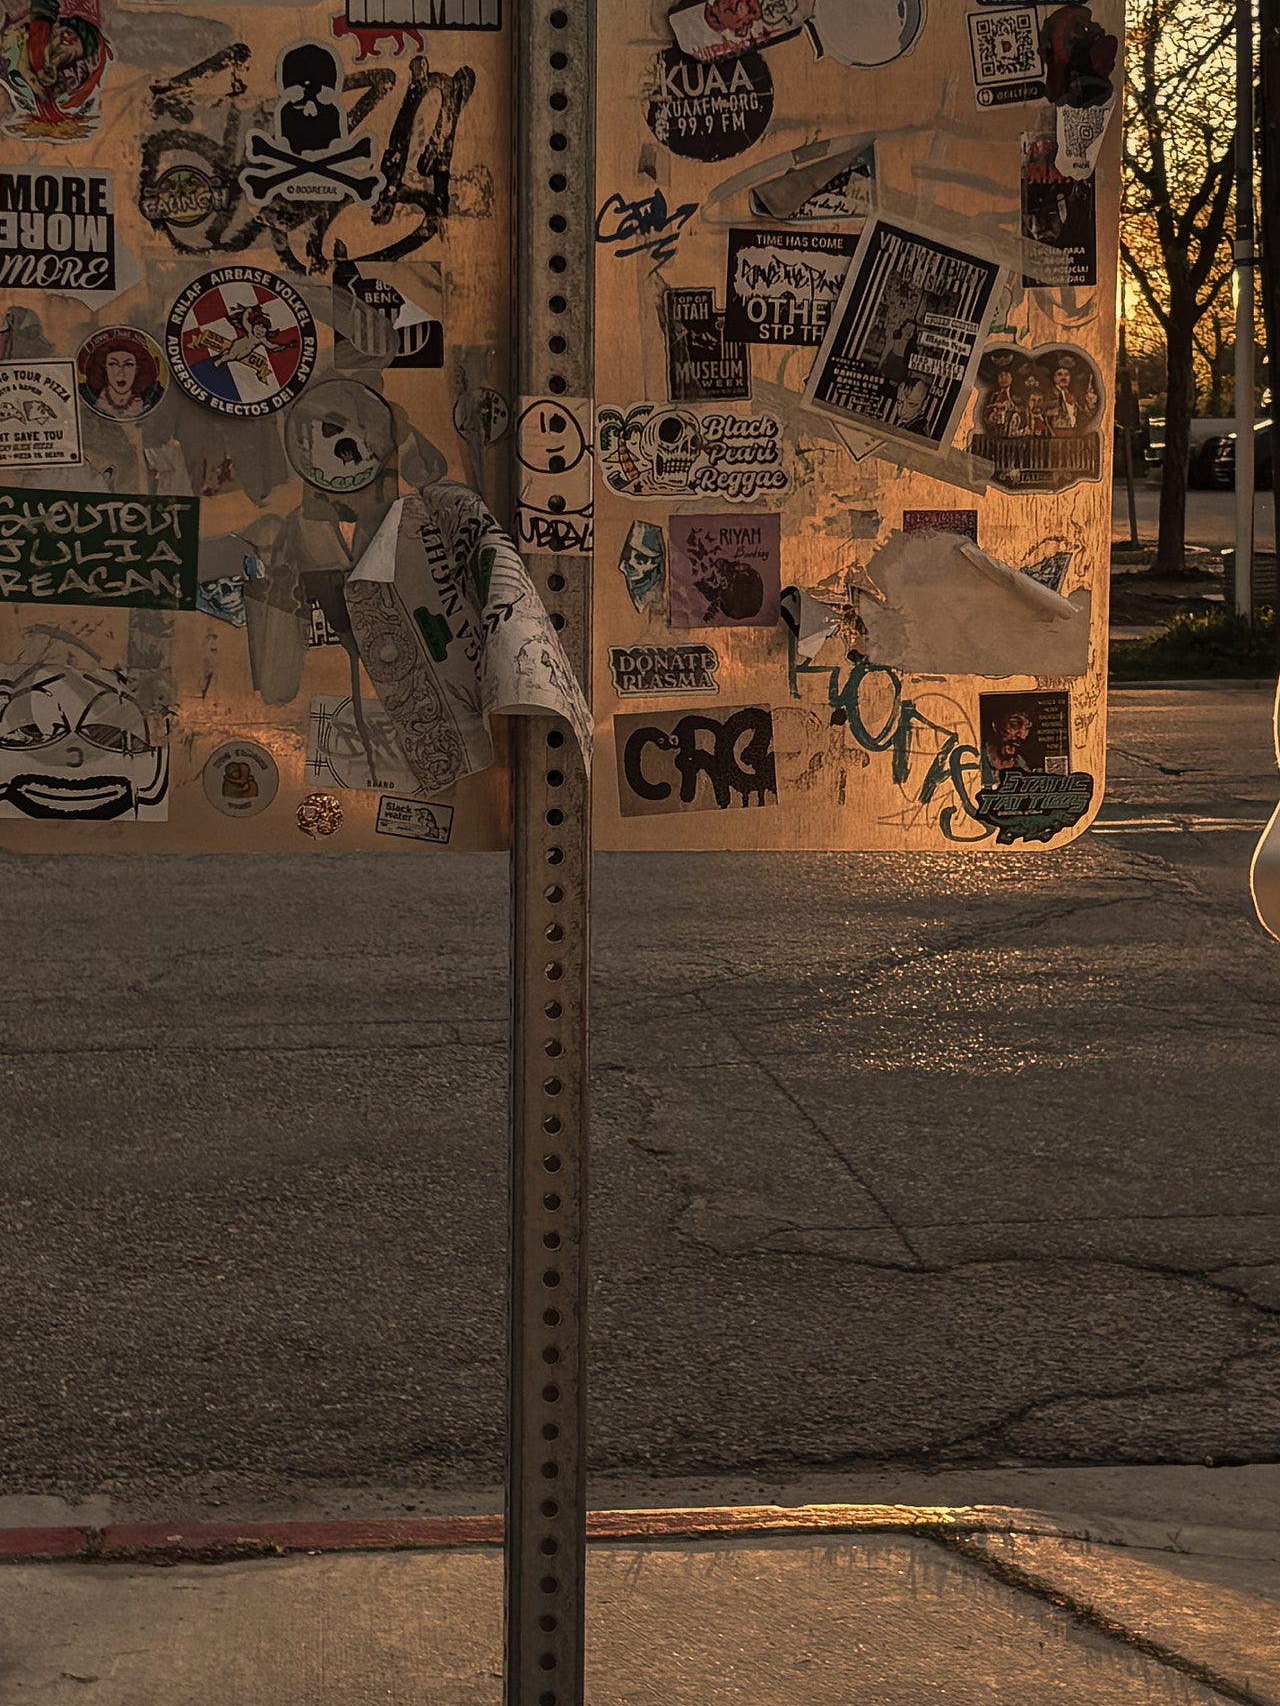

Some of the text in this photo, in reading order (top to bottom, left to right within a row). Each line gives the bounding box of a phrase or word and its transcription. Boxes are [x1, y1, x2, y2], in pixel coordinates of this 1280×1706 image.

[661, 59, 755, 98] KUAA
[678, 112, 746, 137] 99.9 FM
[0, 173, 107, 213] MORE
[0, 212, 107, 252] MORE
[757, 234, 844, 249] TIME HAS COME
[364, 292, 400, 304] BENC
[695, 295, 708, 303] OF
[673, 303, 709, 320] UTAH
[747, 297, 832, 325] OTHE
[171, 268, 315, 383] RNLAF AIRBASE VOLKEL RNLAF
[760, 324, 794, 340] STP
[168, 335, 208, 401] ADVERSUS
[210, 397, 269, 415] ELECTOS
[674, 360, 743, 383] MUSEUM
[701, 379, 744, 387] WEEK
[43, 377, 71, 403] PIZZA
[14, 431, 40, 441] SAVE
[703, 414, 778, 443] Black
[707, 442, 777, 466] Pearl
[695, 467, 788, 499] Reggae
[420, 524, 463, 617] NIGHT
[620, 652, 717, 672] DONATE
[622, 671, 714, 690] PLASMA
[384, 811, 413, 822] water
[385, 802, 412, 814] Slack
